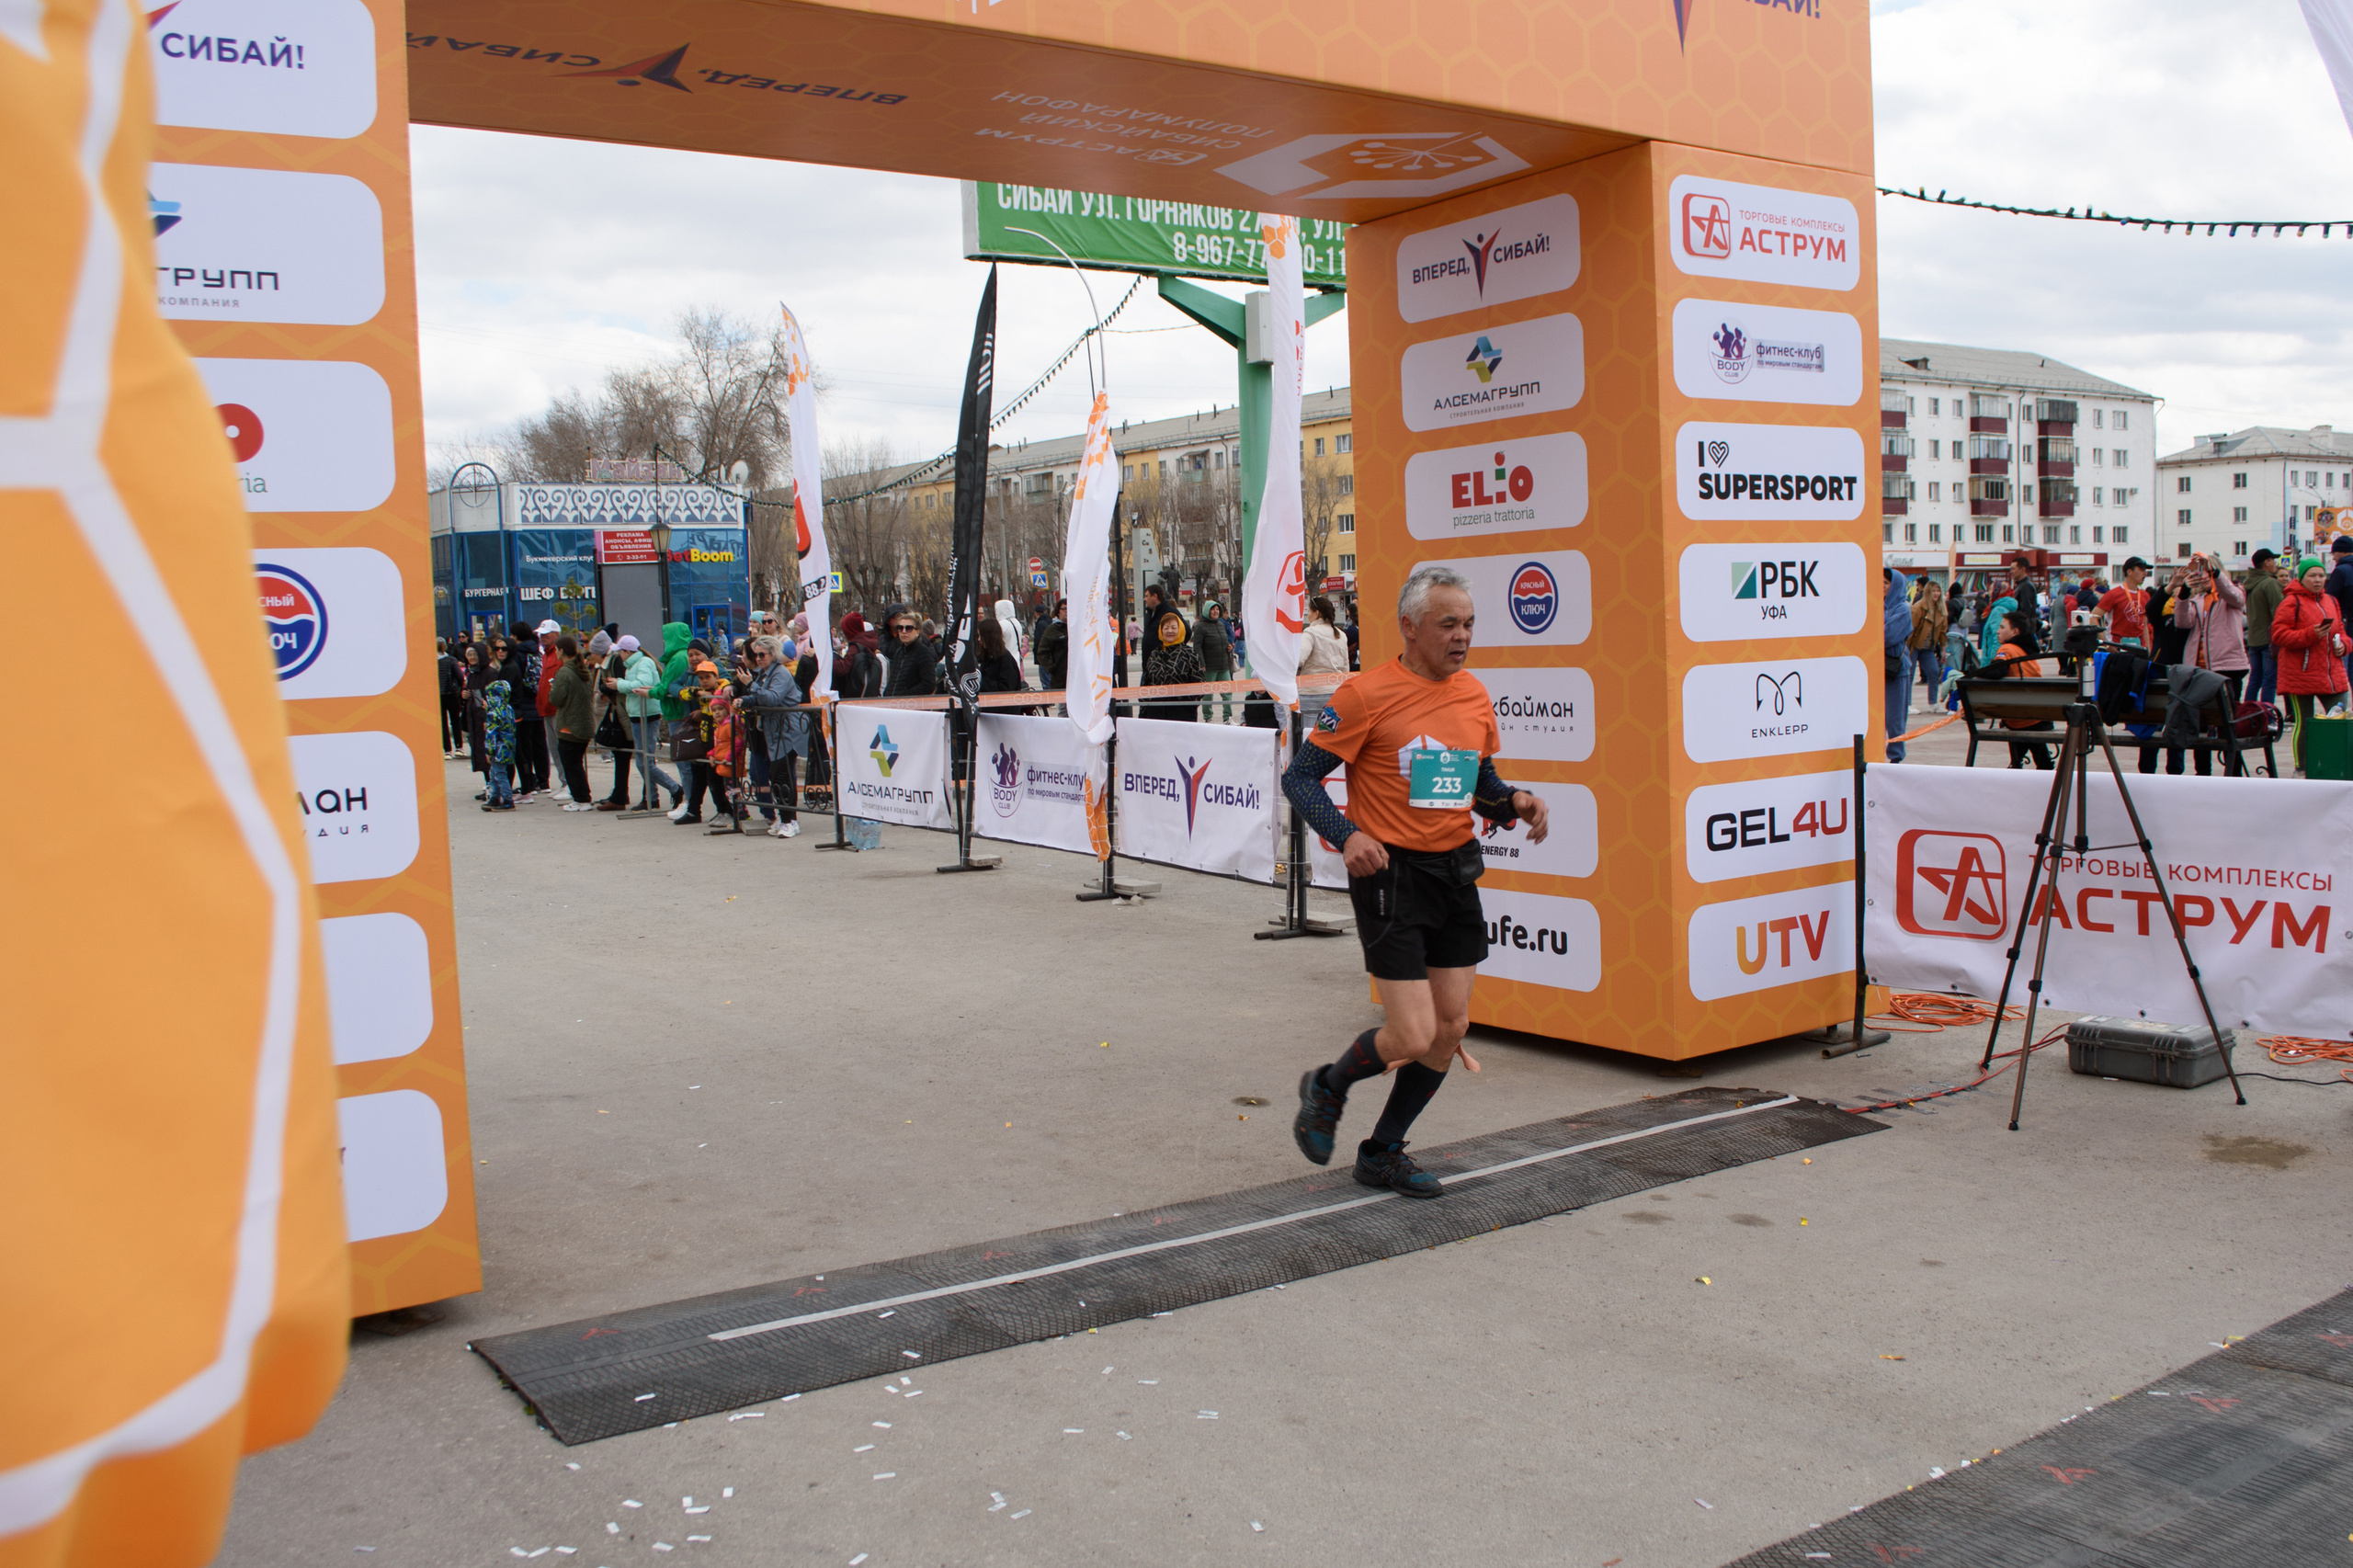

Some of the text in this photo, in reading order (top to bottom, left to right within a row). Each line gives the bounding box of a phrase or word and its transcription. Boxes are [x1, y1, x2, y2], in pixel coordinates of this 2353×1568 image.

[161, 32, 305, 70] СИБАЙ!
[697, 67, 910, 107] ВПЕРЕД,
[991, 90, 1275, 138] ПОЛУМАРАФОН
[973, 128, 1139, 155] АСТРУМ
[1018, 111, 1242, 151] СИБАЙСКИЙ
[1738, 209, 1846, 233] ТОРГОВЫЕ КОМПЛЕКСЫ
[1173, 231, 1347, 276] 8-967-77-0-11
[1738, 226, 1847, 263] АСТРУМ
[1412, 233, 1551, 285] ВПЕРЕД, СИБАЙ!
[158, 296, 240, 308] КОМПАНИЯ
[1756, 342, 1821, 361] фитнес-клуб
[1717, 359, 1745, 371] BODY
[1765, 360, 1790, 369] мировым
[1433, 381, 1540, 412] АЛСЕМАГРУПП
[1493, 402, 1526, 412] КОМПАНИЯ
[1698, 472, 1858, 502] SUPERSPORT
[1453, 507, 1535, 529] pizzeria trattoria
[526, 554, 577, 563] Букмекерский
[1520, 579, 1546, 590] КРАСНЫЙ
[1761, 560, 1820, 599] РБК
[464, 586, 509, 598] БУРГЕРНАЯ
[520, 586, 554, 601] ШЕФ
[1520, 600, 1546, 617] КЛЮЧ
[1761, 604, 1788, 621] УФА
[1524, 724, 1574, 733] студия
[1751, 723, 1809, 739] ENKLEPP
[847, 781, 934, 804] АЛСЕМАГРУПП
[994, 788, 1017, 802] BODY
[1036, 789, 1061, 799] мировым
[1124, 771, 1260, 811] ВПЕРЕД, СИБАЙ!
[1432, 777, 1461, 793] 233
[1706, 797, 1848, 853] GEL4U
[1481, 845, 1519, 858] ENERGY 88
[2168, 863, 2333, 892] КОМПЛЕКСЫ
[2028, 883, 2332, 954] АСТРУМ
[1736, 910, 1830, 976] UTV
